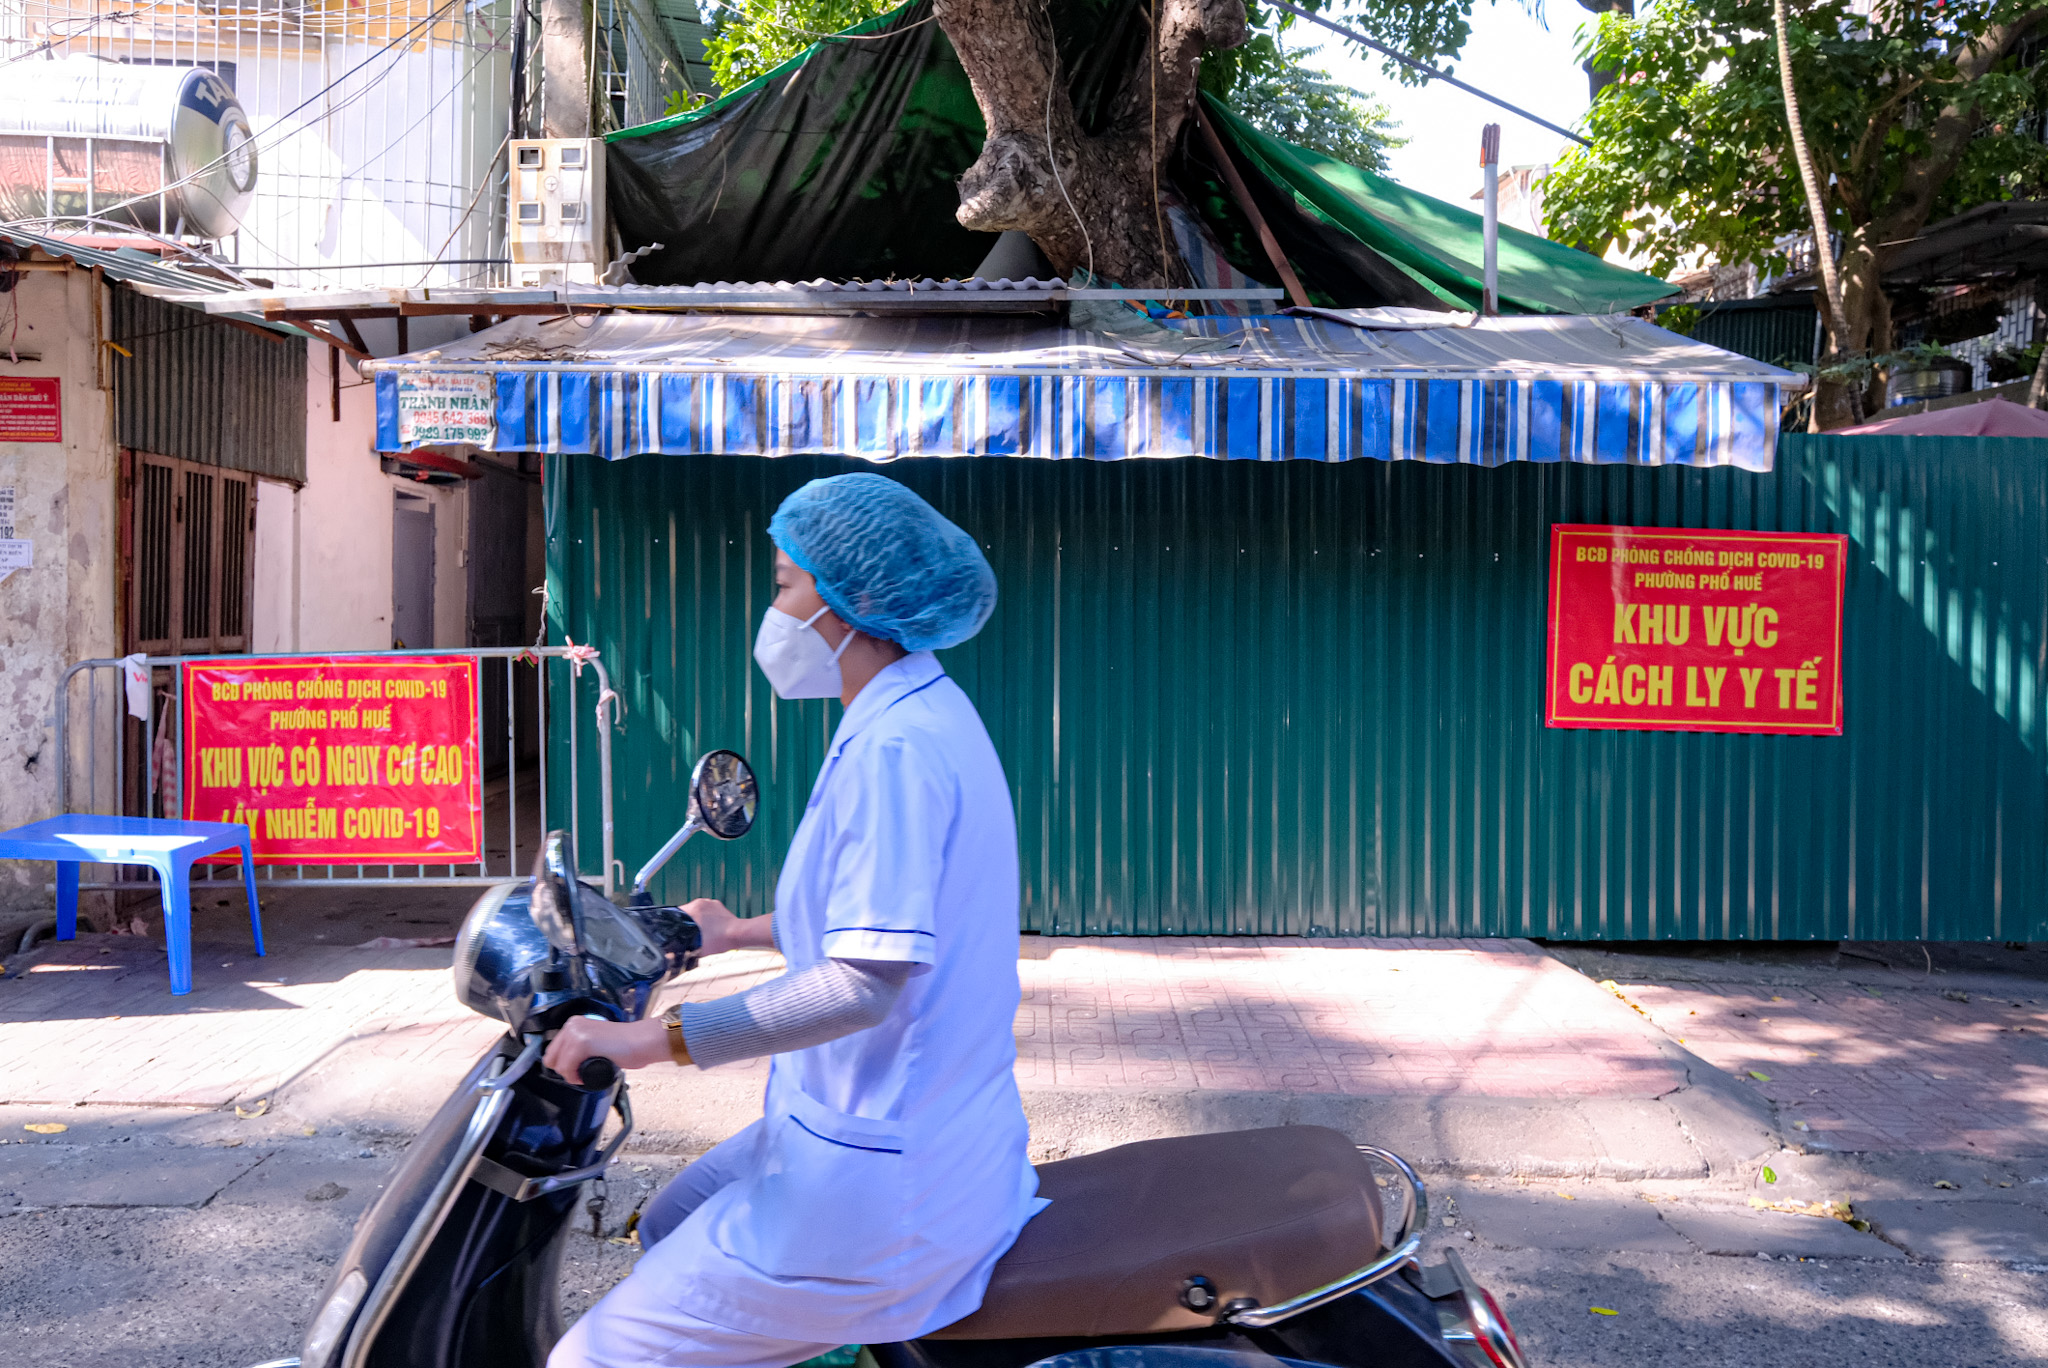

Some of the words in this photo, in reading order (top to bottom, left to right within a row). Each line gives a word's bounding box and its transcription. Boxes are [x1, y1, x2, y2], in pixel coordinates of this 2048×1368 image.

[400, 393, 447, 409] THÀNH
[450, 394, 489, 410] NHÂN
[442, 411, 463, 425] 642
[467, 412, 487, 425] 368
[412, 426, 440, 439] 0989
[444, 427, 465, 440] 175
[467, 428, 487, 440] 993
[1576, 547, 1607, 562] BCĐ
[1611, 546, 1660, 564] PHÒNG
[1664, 546, 1714, 566] CHỐNG
[1719, 551, 1754, 570] DỊCH
[1758, 554, 1824, 569] COVID-19
[1635, 569, 1695, 589] PHƯỜNG
[1700, 569, 1733, 590] PHỐ
[1734, 571, 1763, 591] HUẾ
[1614, 603, 1690, 645] KHU
[1703, 602, 1779, 656] VỰC
[212, 682, 240, 701] BCĐ
[243, 677, 293, 700] PHÒNG
[296, 673, 342, 699] CHỐNG
[347, 680, 382, 702] DỊCH
[385, 679, 447, 698] COVID-19
[1569, 655, 1673, 706] CÁCH
[1686, 666, 1727, 707] LY
[1739, 668, 1763, 708] Y
[1774, 656, 1822, 710] TẾ
[270, 707, 327, 730] PHƯỜNG
[331, 703, 359, 729] PHỐ
[362, 704, 392, 729] HUẾ
[201, 747, 241, 787] KHU
[247, 742, 285, 796] VỰC
[291, 737, 321, 786] CÓ
[326, 746, 381, 785] NGUY
[387, 741, 416, 785] CƠ
[421, 744, 463, 785] CAO
[265, 796, 337, 839] NHIỄM
[343, 807, 440, 839] COVID-19
